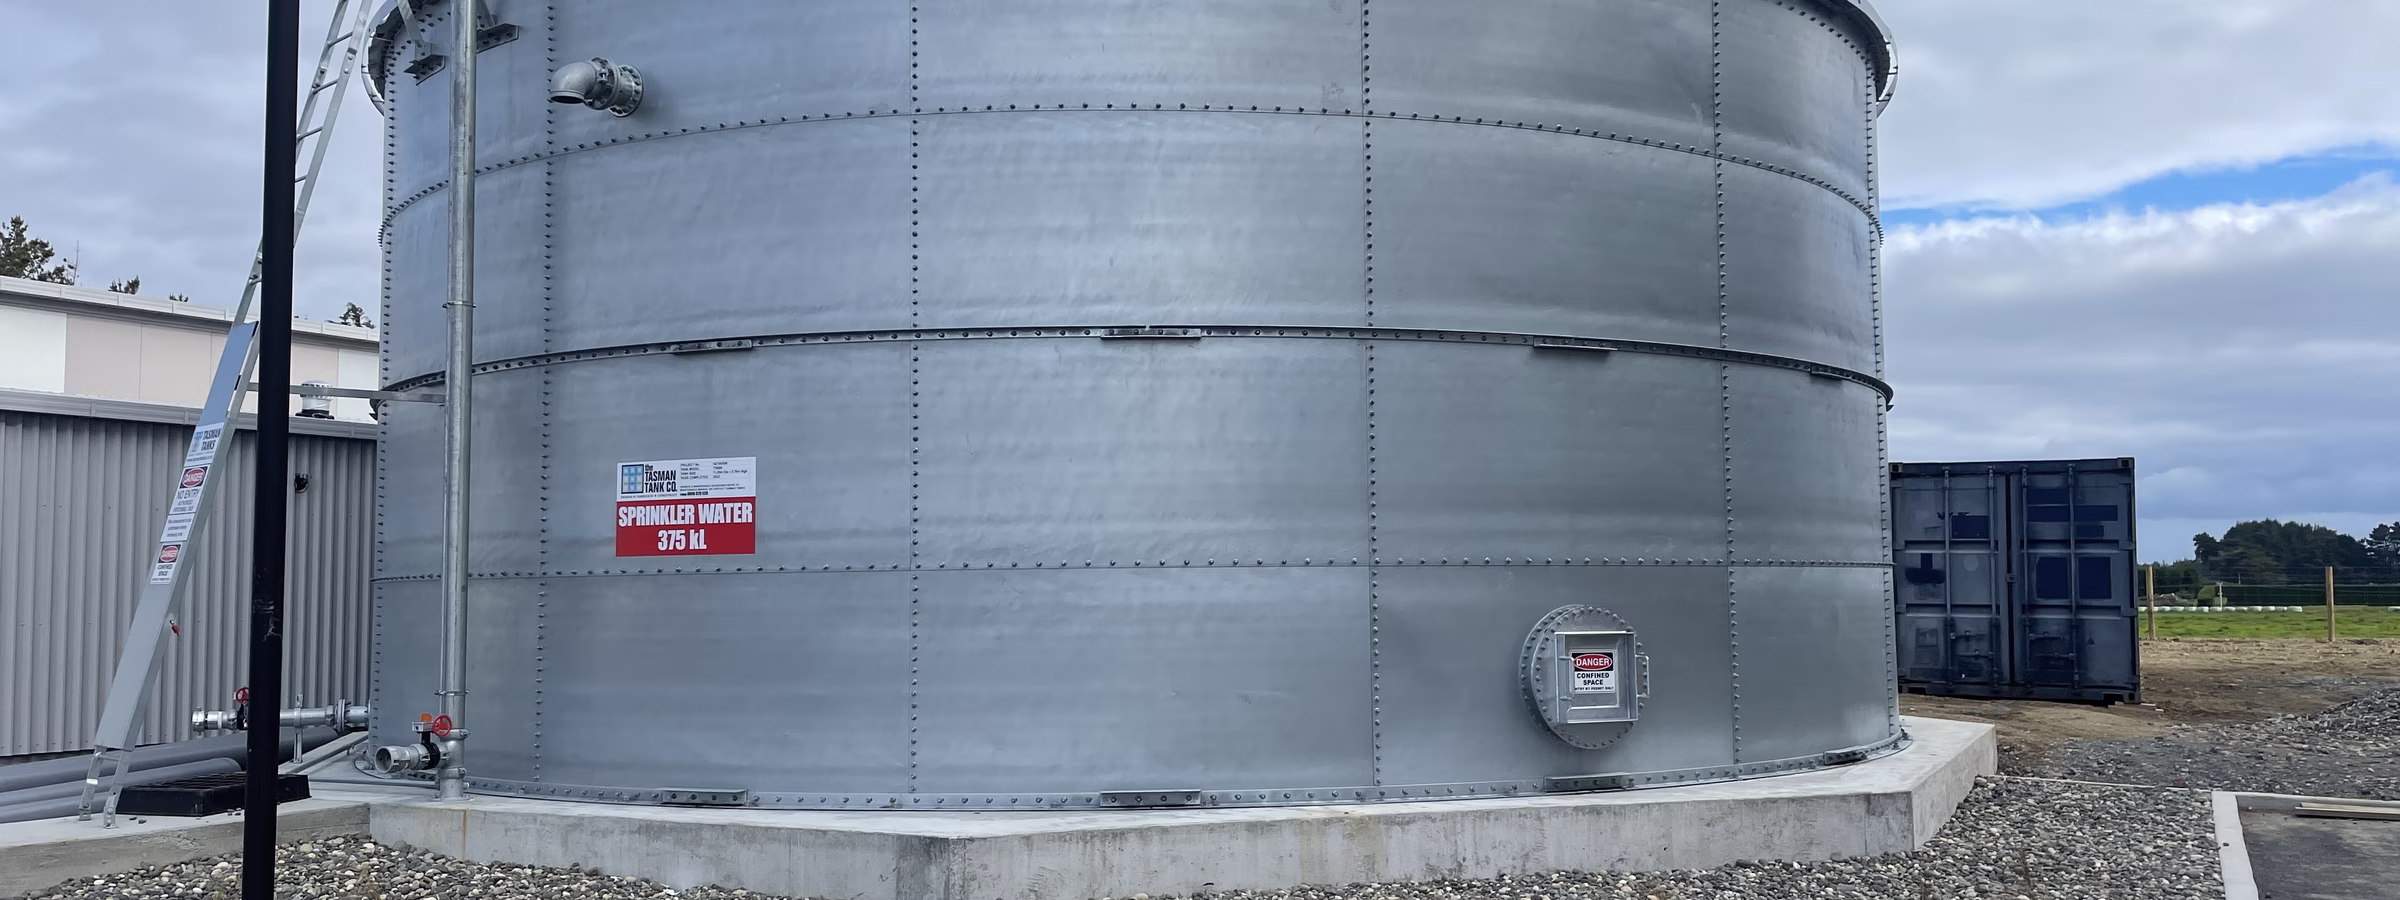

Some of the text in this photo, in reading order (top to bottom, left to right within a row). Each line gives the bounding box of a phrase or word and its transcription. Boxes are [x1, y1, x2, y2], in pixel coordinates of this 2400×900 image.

[645, 470, 677, 482] TASMAN
[645, 482, 665, 493] TANK
[618, 502, 753, 527] SPRINKLER WATER
[657, 529, 707, 550] 375 kL
[1576, 658, 1610, 666] DANGER
